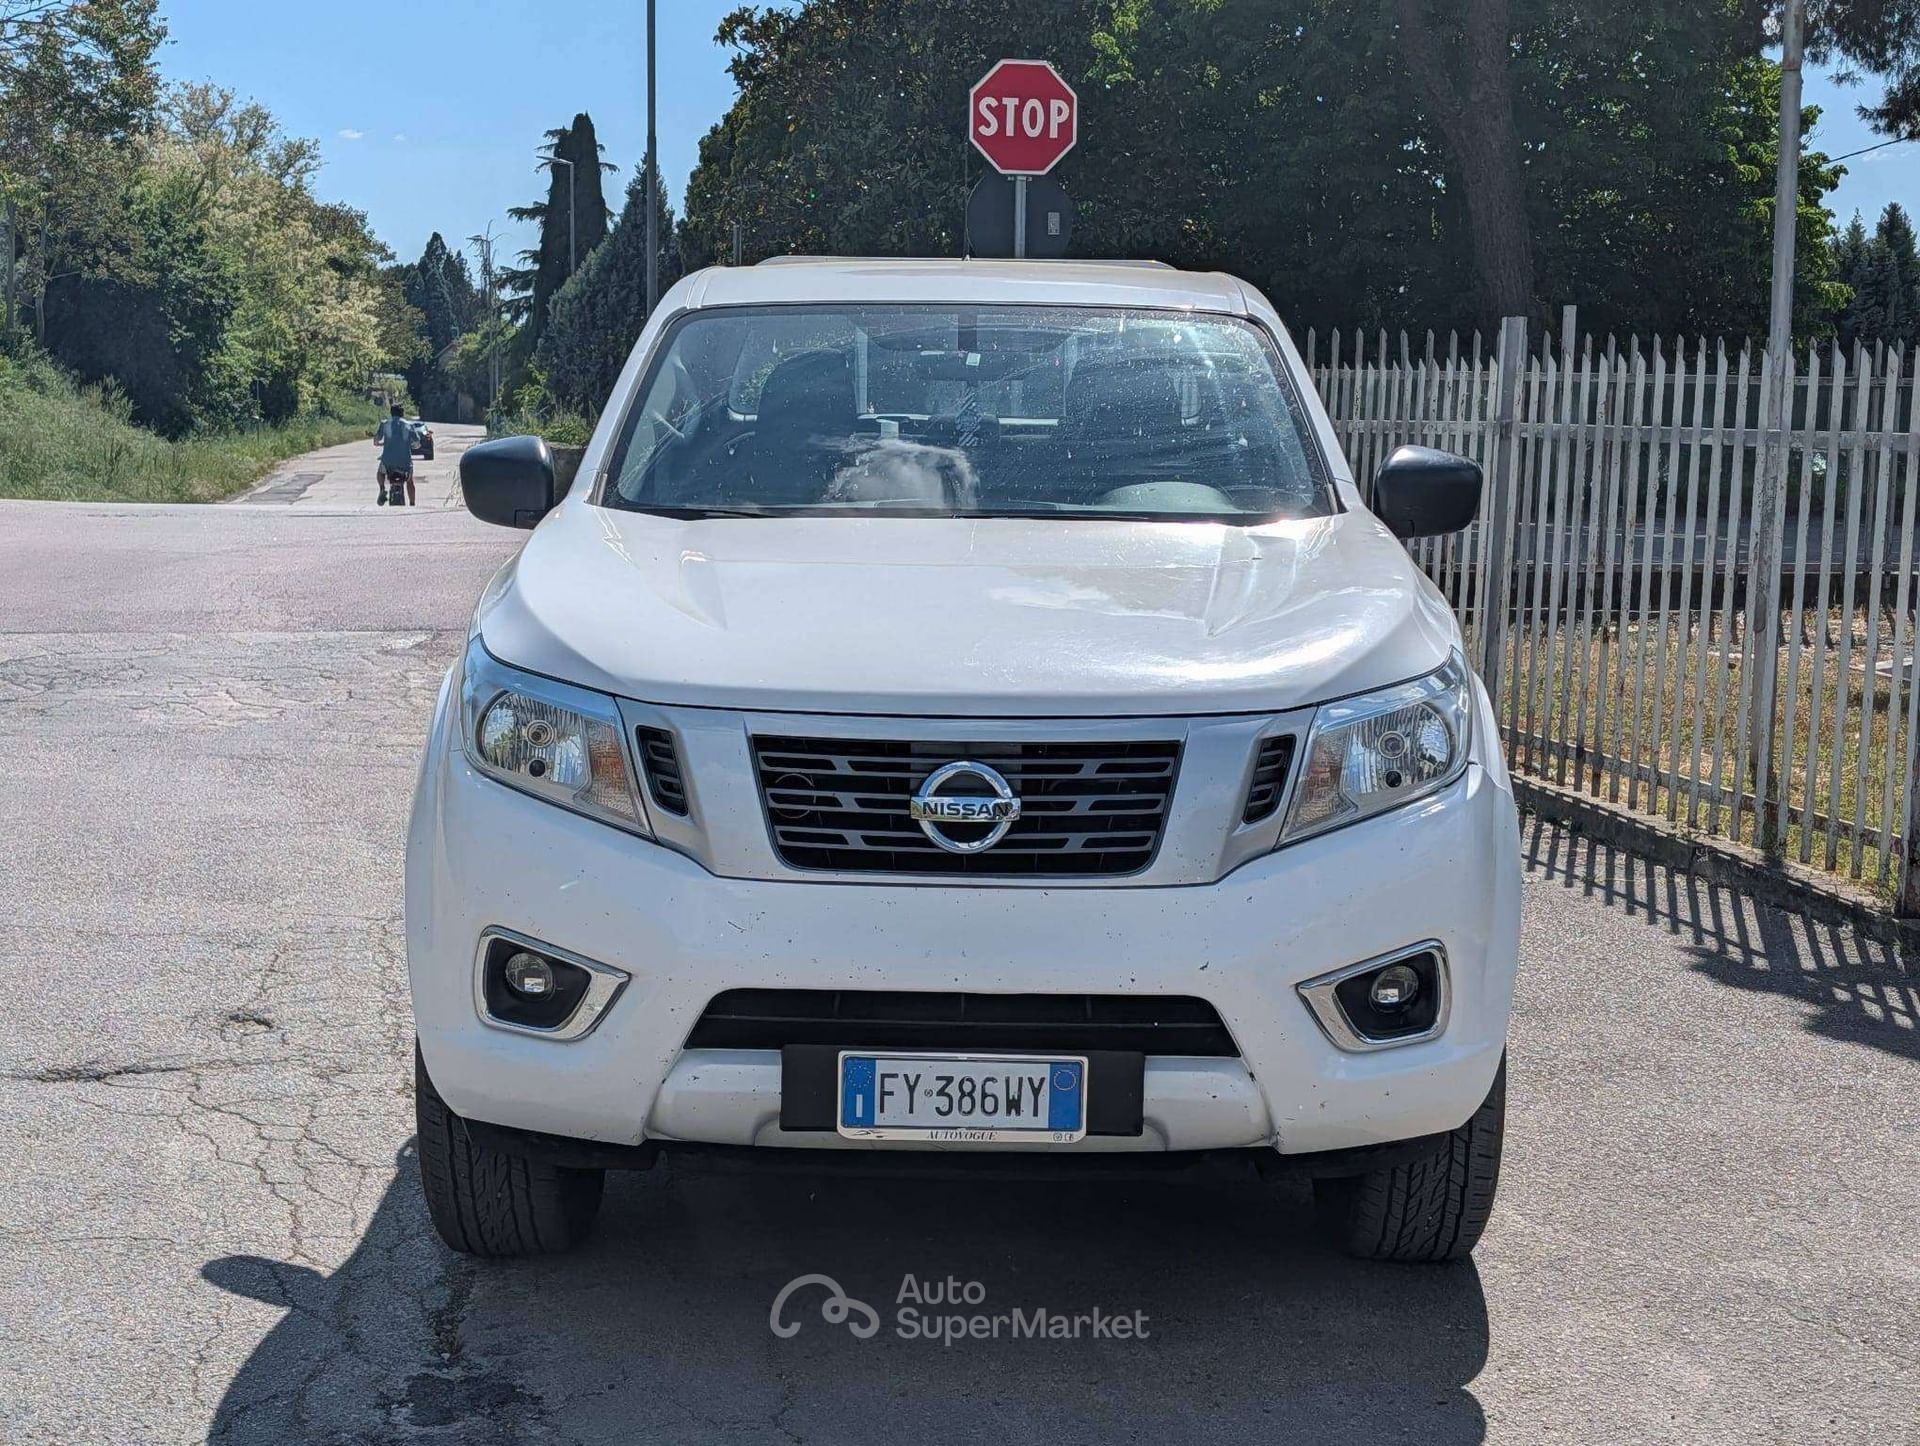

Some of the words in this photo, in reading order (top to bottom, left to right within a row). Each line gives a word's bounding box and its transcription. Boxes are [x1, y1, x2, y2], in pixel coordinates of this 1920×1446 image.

[978, 96, 1070, 139] STOP
[922, 801, 1013, 817] NISSAN
[927, 1130, 998, 1141] AUTOVOGUE
